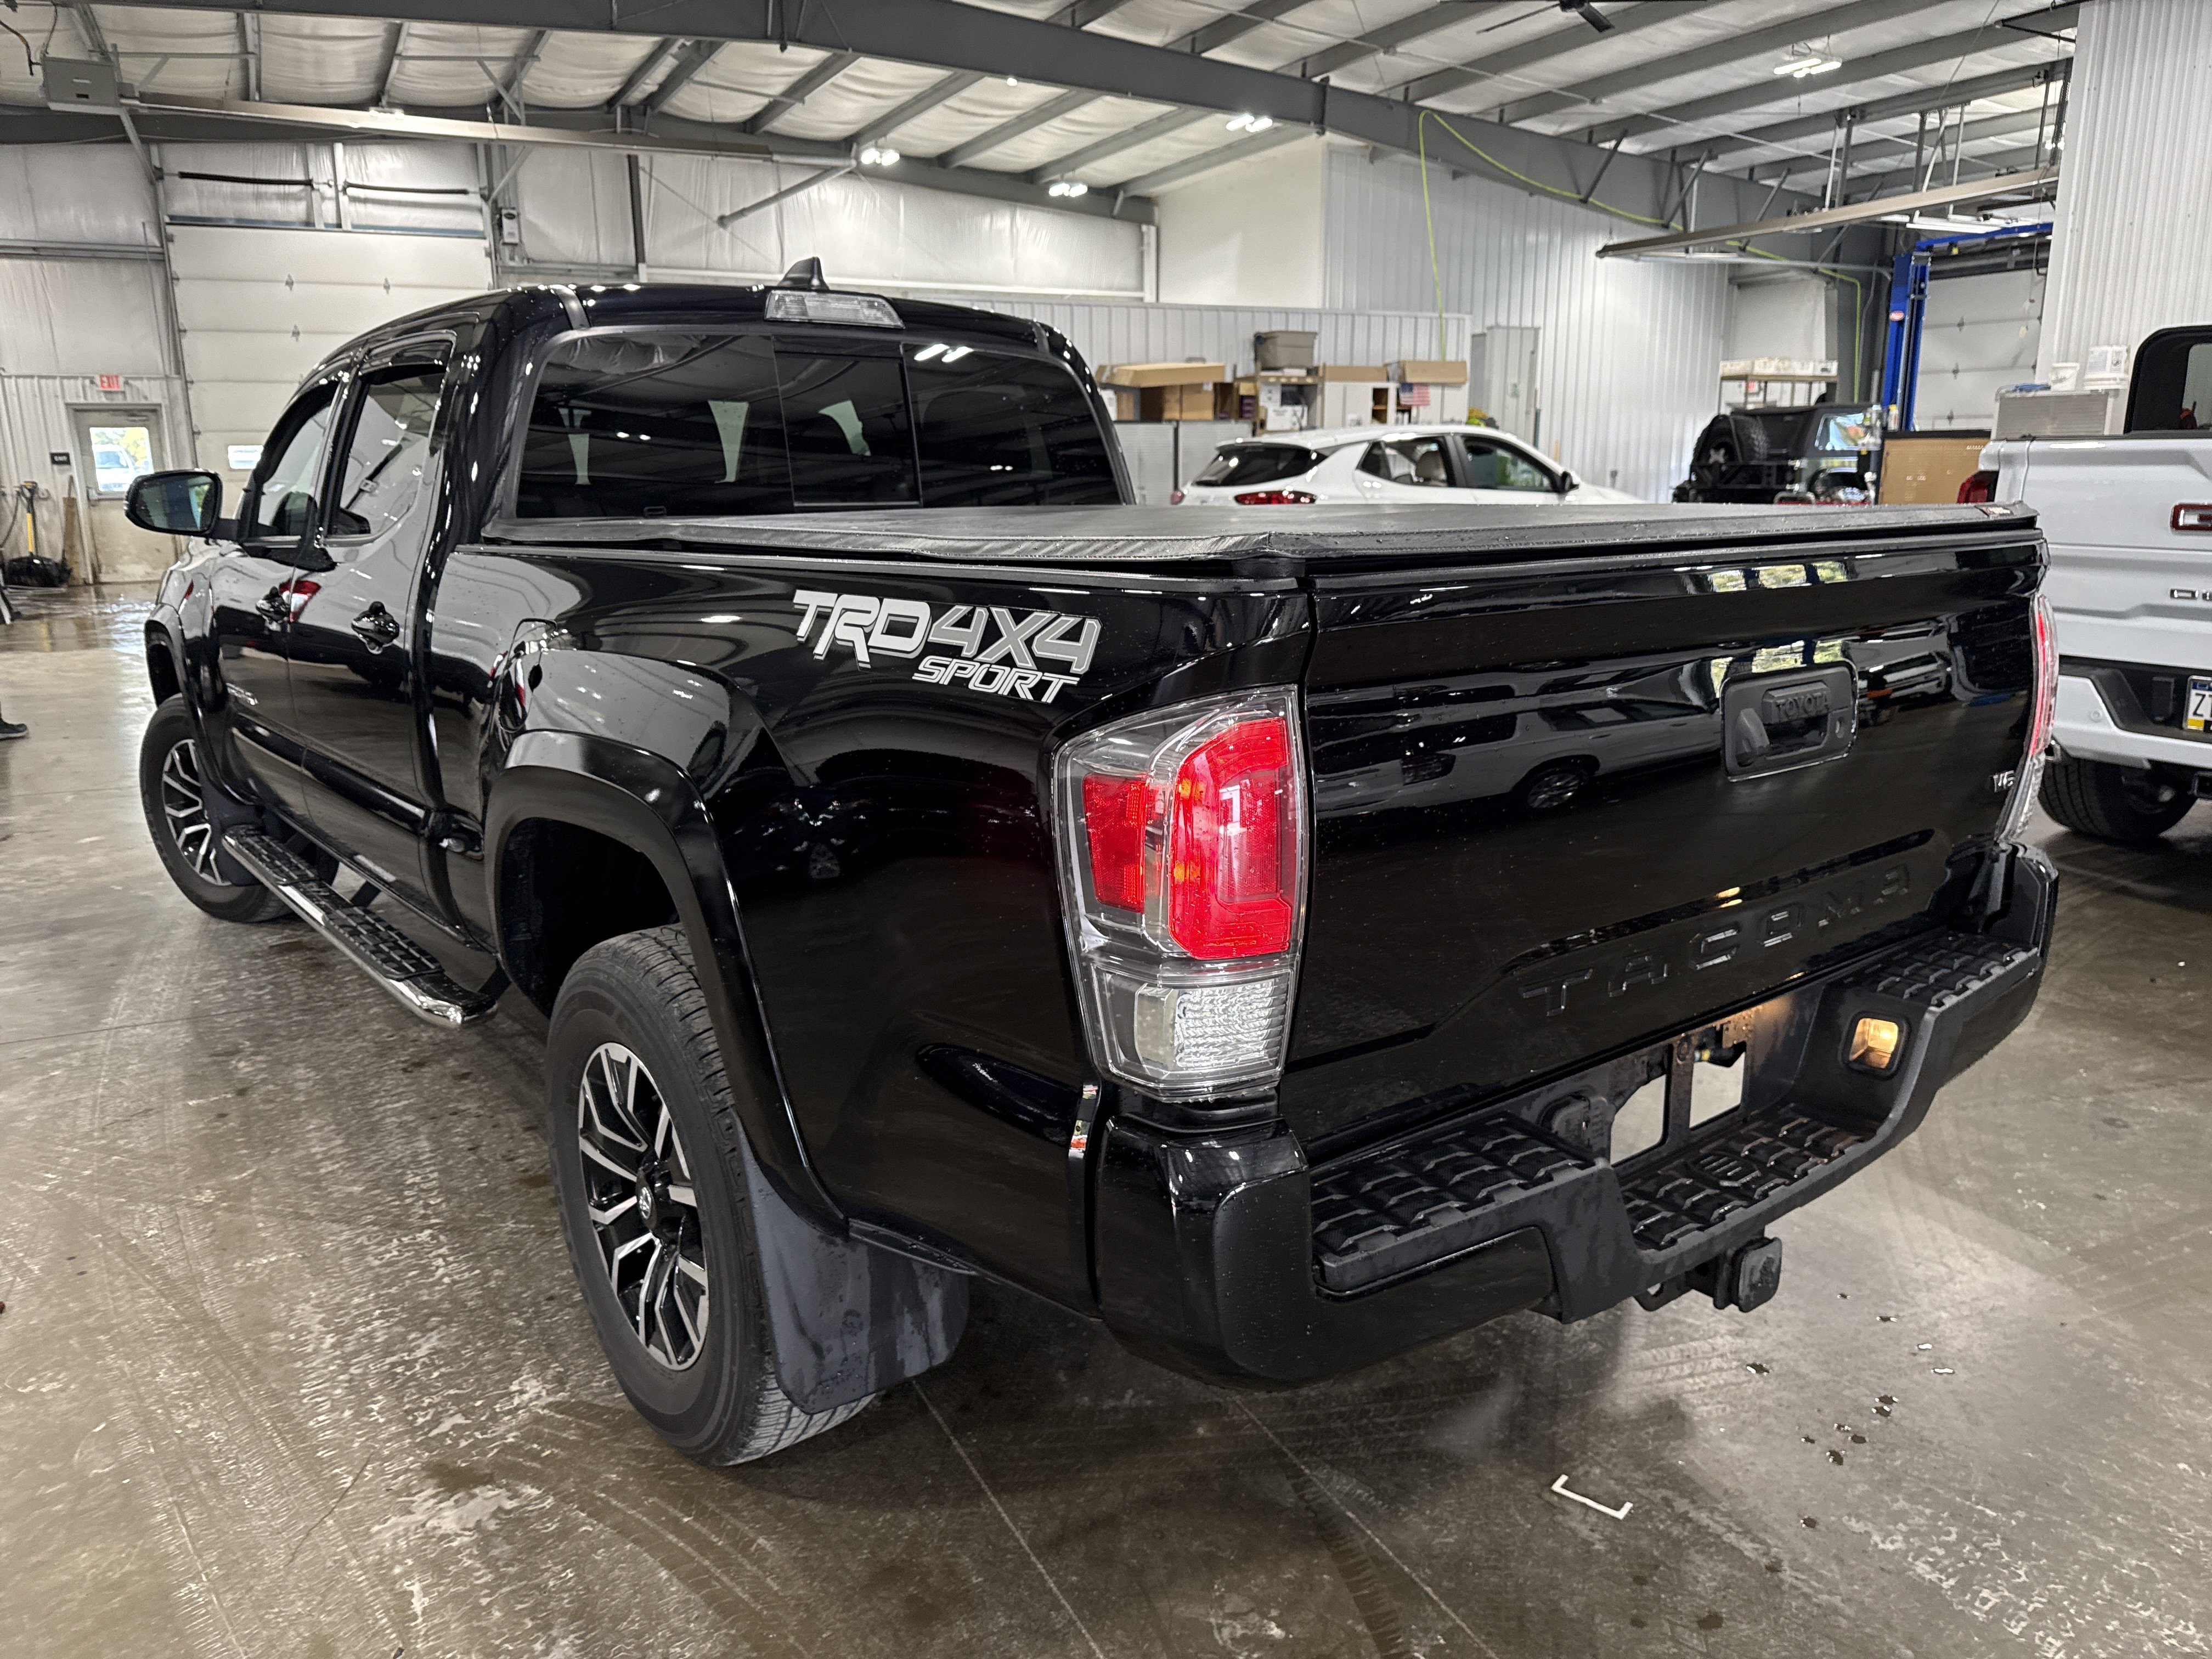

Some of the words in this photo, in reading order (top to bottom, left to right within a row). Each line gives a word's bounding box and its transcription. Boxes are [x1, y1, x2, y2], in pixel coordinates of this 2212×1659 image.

[100, 375, 120, 388] EXIT
[792, 589, 932, 671] TRD
[928, 603, 1102, 675] 4X4
[911, 655, 1081, 704] SPORT
[1775, 691, 1830, 720] TOYOTA
[1521, 862, 1911, 1017] TACOMA
